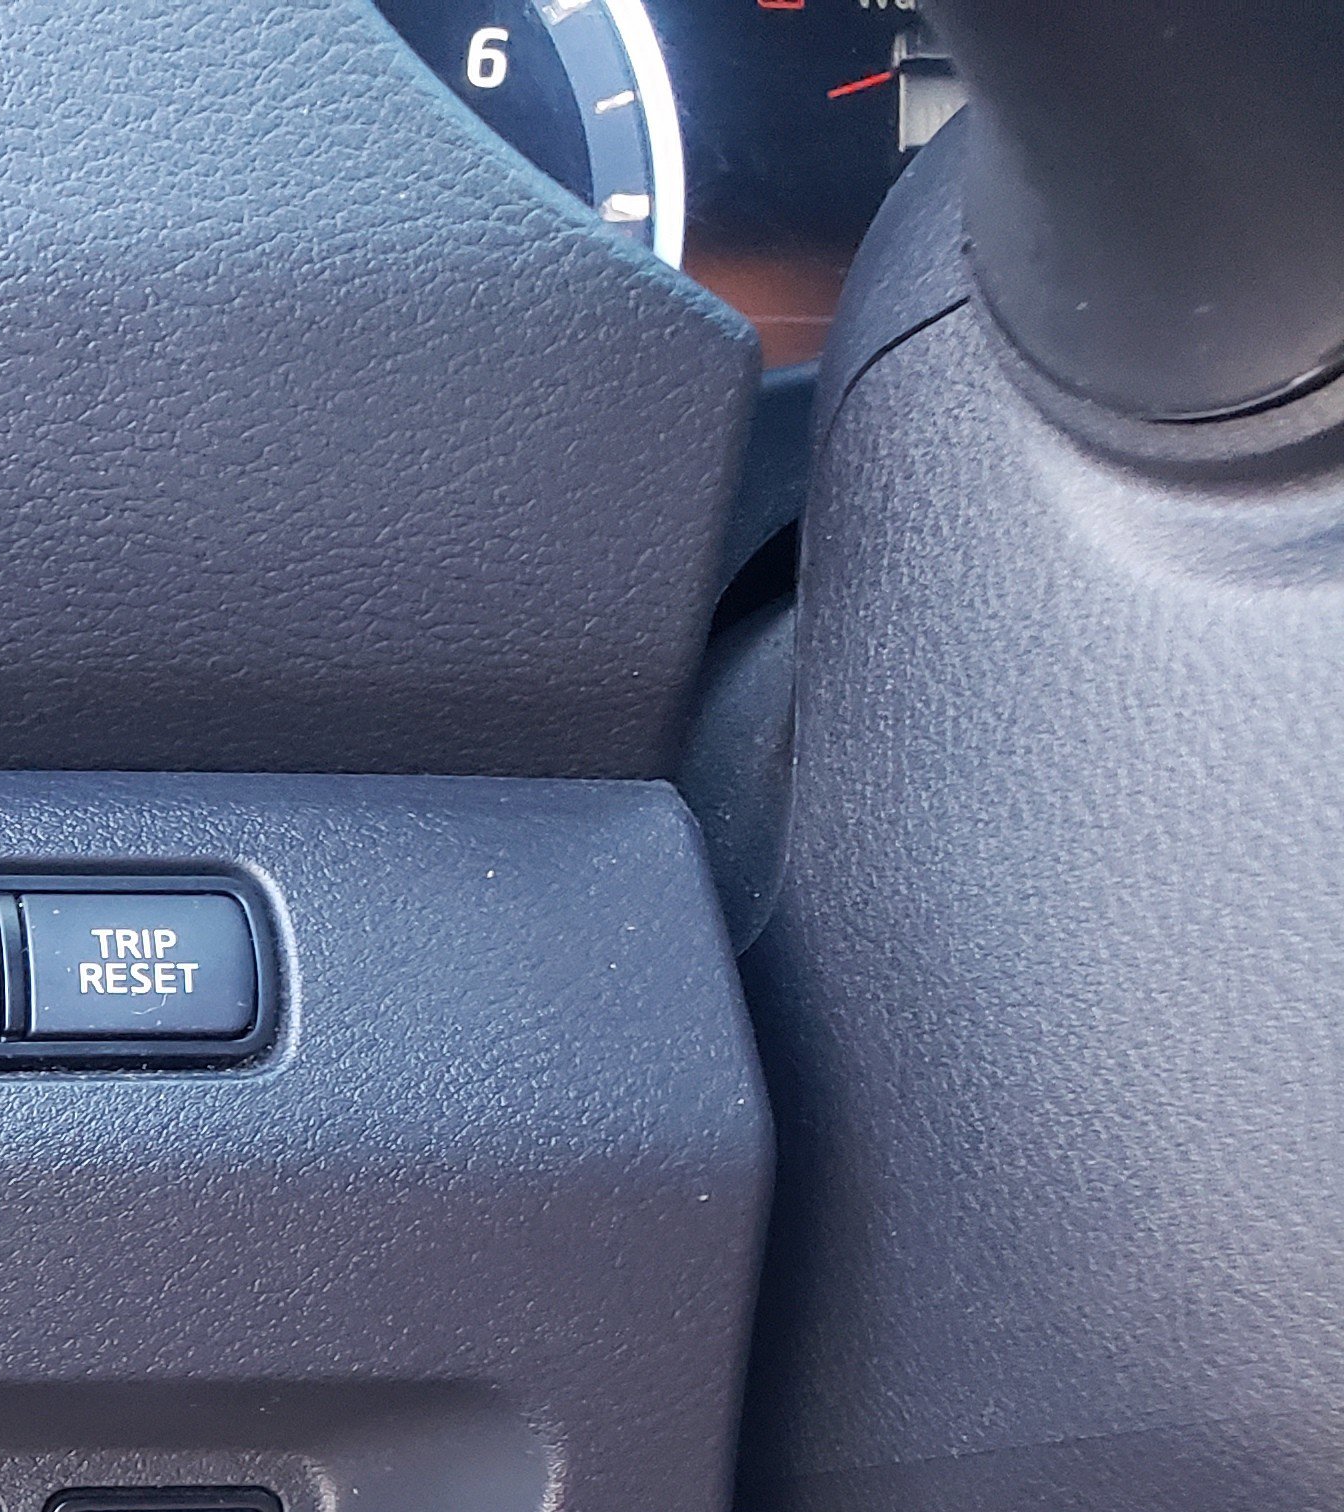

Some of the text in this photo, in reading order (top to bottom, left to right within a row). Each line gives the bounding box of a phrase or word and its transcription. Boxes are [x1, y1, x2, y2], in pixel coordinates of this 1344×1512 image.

[465, 27, 509, 88] 6
[91, 928, 178, 960] TRIP
[79, 962, 199, 994] RESET
